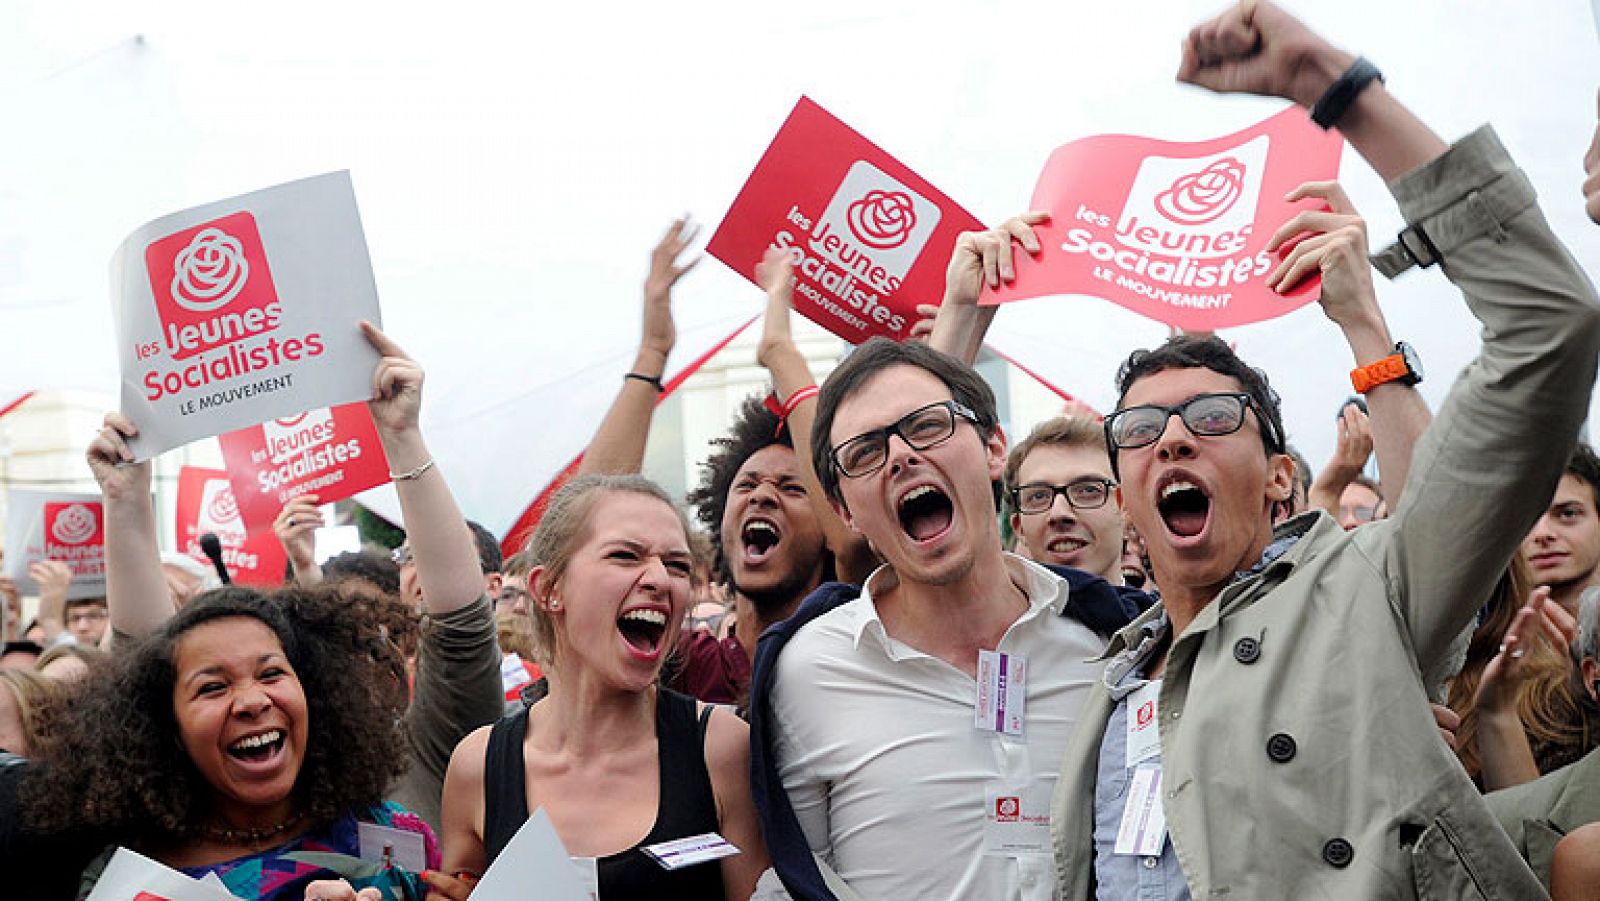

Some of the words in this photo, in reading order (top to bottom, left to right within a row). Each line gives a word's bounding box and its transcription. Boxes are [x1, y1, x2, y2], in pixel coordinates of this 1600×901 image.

[787, 204, 812, 231] les
[811, 222, 901, 294] Jeunes
[1075, 203, 1111, 228] les
[1117, 215, 1253, 254] Jeunes
[1061, 228, 1272, 288] Socialistes
[1092, 265, 1114, 283] LE
[1116, 275, 1233, 309] MOUVEMENT
[135, 341, 161, 361] les
[166, 302, 284, 357] Jeunes
[143, 333, 325, 402] Socialistes
[180, 400, 197, 416] LE
[199, 373, 294, 410] MOUVEMENT
[257, 438, 361, 493] Socialistes
[267, 418, 336, 458] Jeunes
